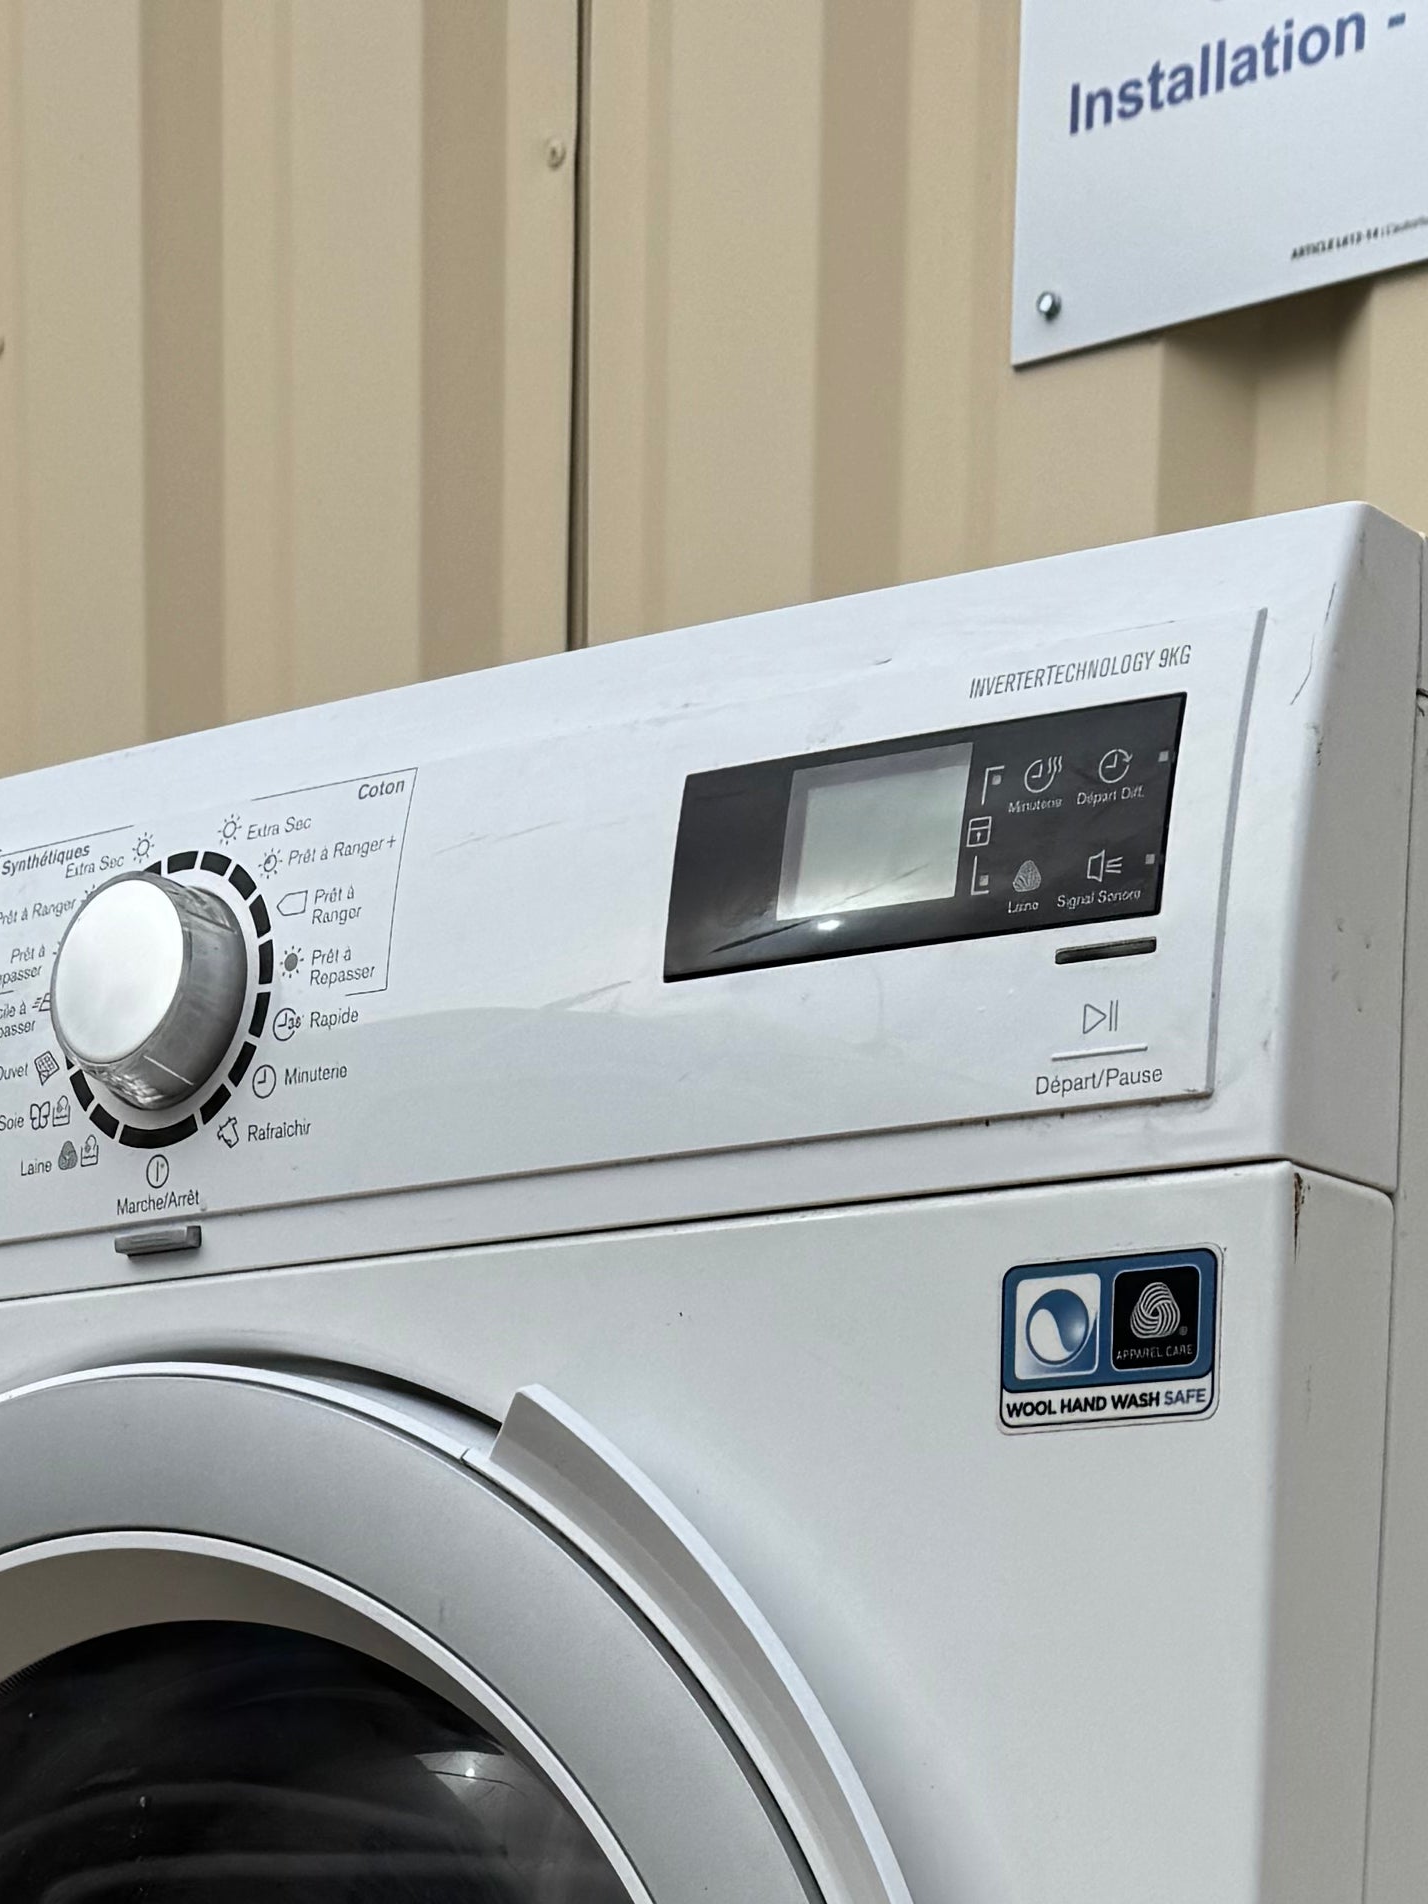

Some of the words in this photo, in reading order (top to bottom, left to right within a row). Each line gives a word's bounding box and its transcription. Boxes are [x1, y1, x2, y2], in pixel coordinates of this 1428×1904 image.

[1069, 12, 1366, 136] Installation
[970, 650, 1156, 700] INVERTERTECHNOLOGY
[1158, 645, 1192, 668] 9KG
[358, 780, 405, 800] Coton
[247, 824, 279, 840] Extra
[284, 817, 312, 833] Sec
[1, 845, 90, 877] Synthétiques
[287, 849, 316, 866] Prêt
[320, 846, 328, 860] à
[65, 863, 95, 878] Extra
[99, 856, 124, 870] Sec
[314, 887, 343, 905] Prêt
[347, 884, 354, 900] à
[1057, 892, 1095, 910] Signal
[21, 909, 28, 920] à
[32, 899, 76, 917] Ranger
[312, 907, 362, 925] Ranger
[10, 948, 34, 963] Prêt
[38, 945, 45, 958] à
[311, 949, 339, 966] Prêt
[344, 945, 351, 961] à
[310, 966, 375, 987] Repasser
[19, 1002, 26, 1015] à
[310, 1006, 359, 1030] Rapide
[284, 1062, 348, 1086] Minuterie
[1035, 1065, 1163, 1098] Départ/Pause
[21, 1159, 52, 1176] Laine
[117, 1189, 200, 1216] Marche/Arrêt
[1166, 1344, 1193, 1357] CARE
[1007, 1400, 1056, 1418] WOOL
[1061, 1396, 1107, 1414] HAND
[1112, 1391, 1160, 1409] WASH
[1164, 1388, 1207, 1405] SAFE
